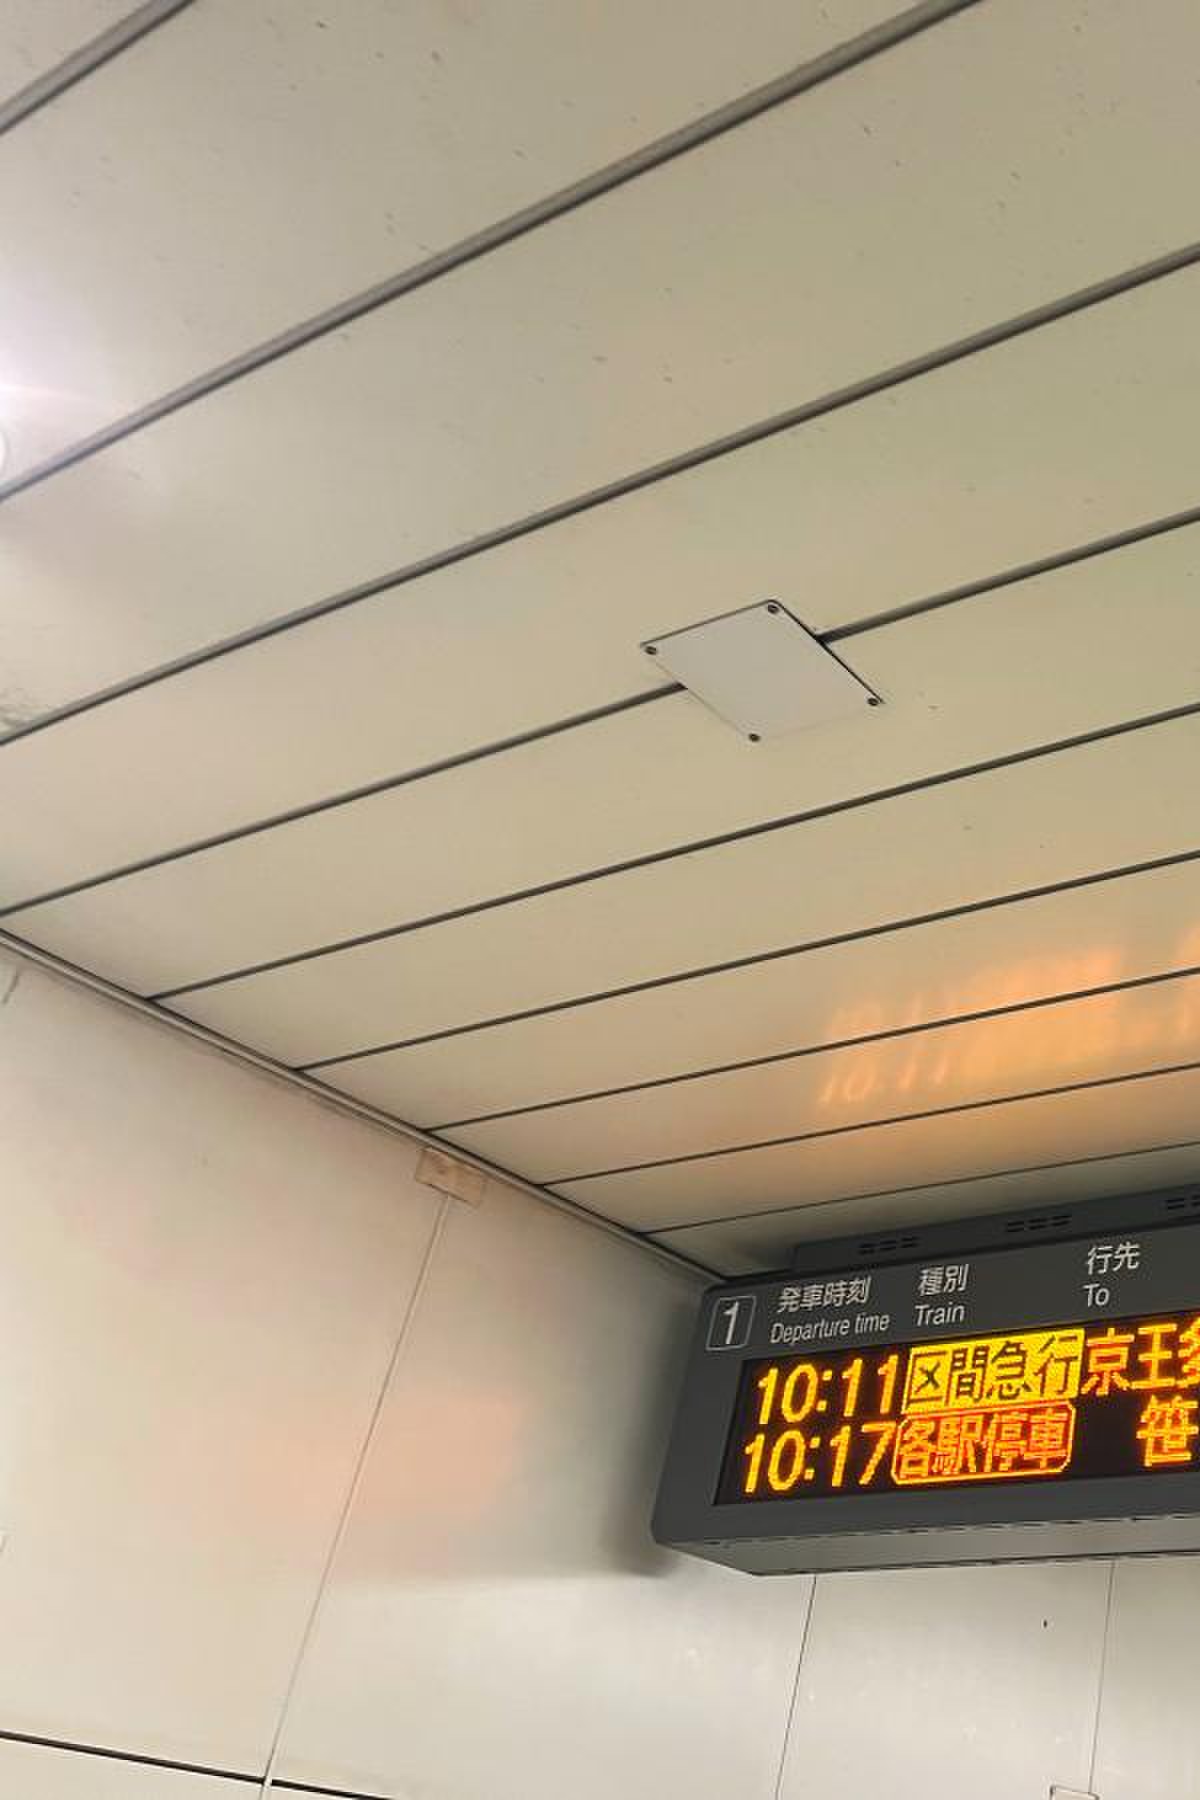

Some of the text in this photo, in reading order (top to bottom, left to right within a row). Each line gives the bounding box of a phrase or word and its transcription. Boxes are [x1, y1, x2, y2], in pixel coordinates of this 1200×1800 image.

[1085, 1240, 1142, 1276] 行先
[776, 1275, 872, 1314] 発車時刻
[916, 1263, 970, 1297] 種別
[1082, 1282, 1110, 1308] To
[723, 1301, 740, 1345] 1
[769, 1312, 891, 1346] Departure time
[914, 1302, 966, 1327] Train
[757, 1354, 899, 1426] 10:11
[909, 1333, 1080, 1403] 区間急行
[744, 1420, 899, 1494] 10:17
[899, 1403, 1069, 1478] 各駅停車
